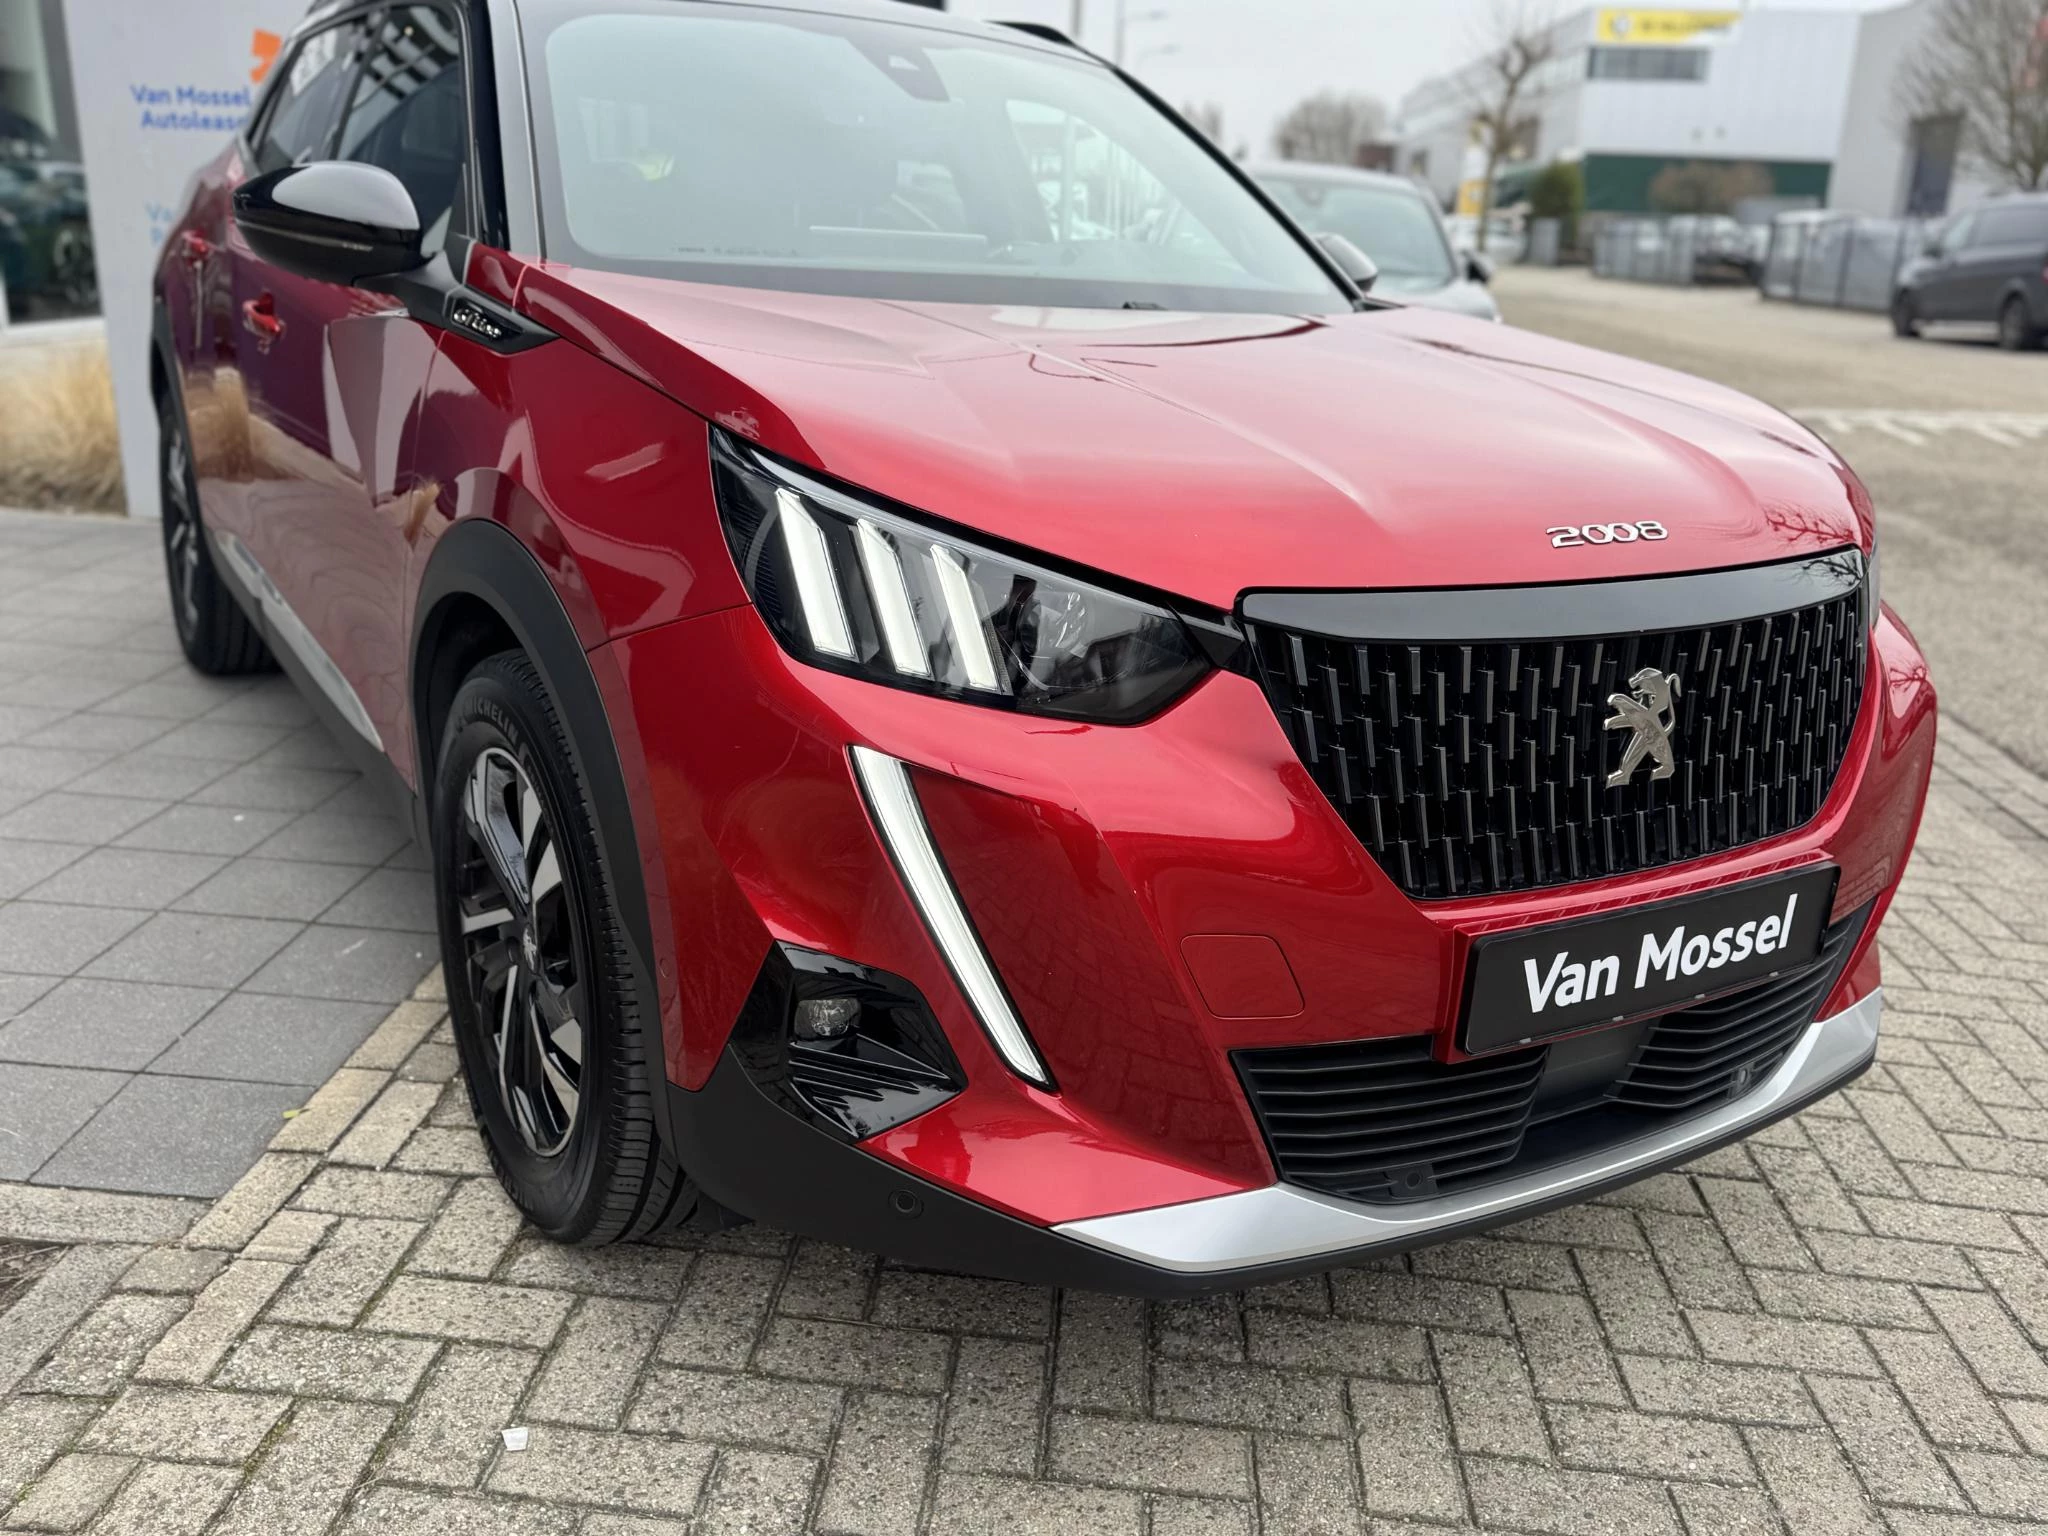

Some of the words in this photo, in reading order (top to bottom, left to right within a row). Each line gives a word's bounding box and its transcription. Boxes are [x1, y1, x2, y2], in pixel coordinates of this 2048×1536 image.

[130, 85, 172, 105] Van
[176, 85, 251, 106] Mossel
[1546, 520, 1668, 548] 2008
[1523, 951, 1620, 1014] Van
[1634, 893, 1798, 990] Mossel
